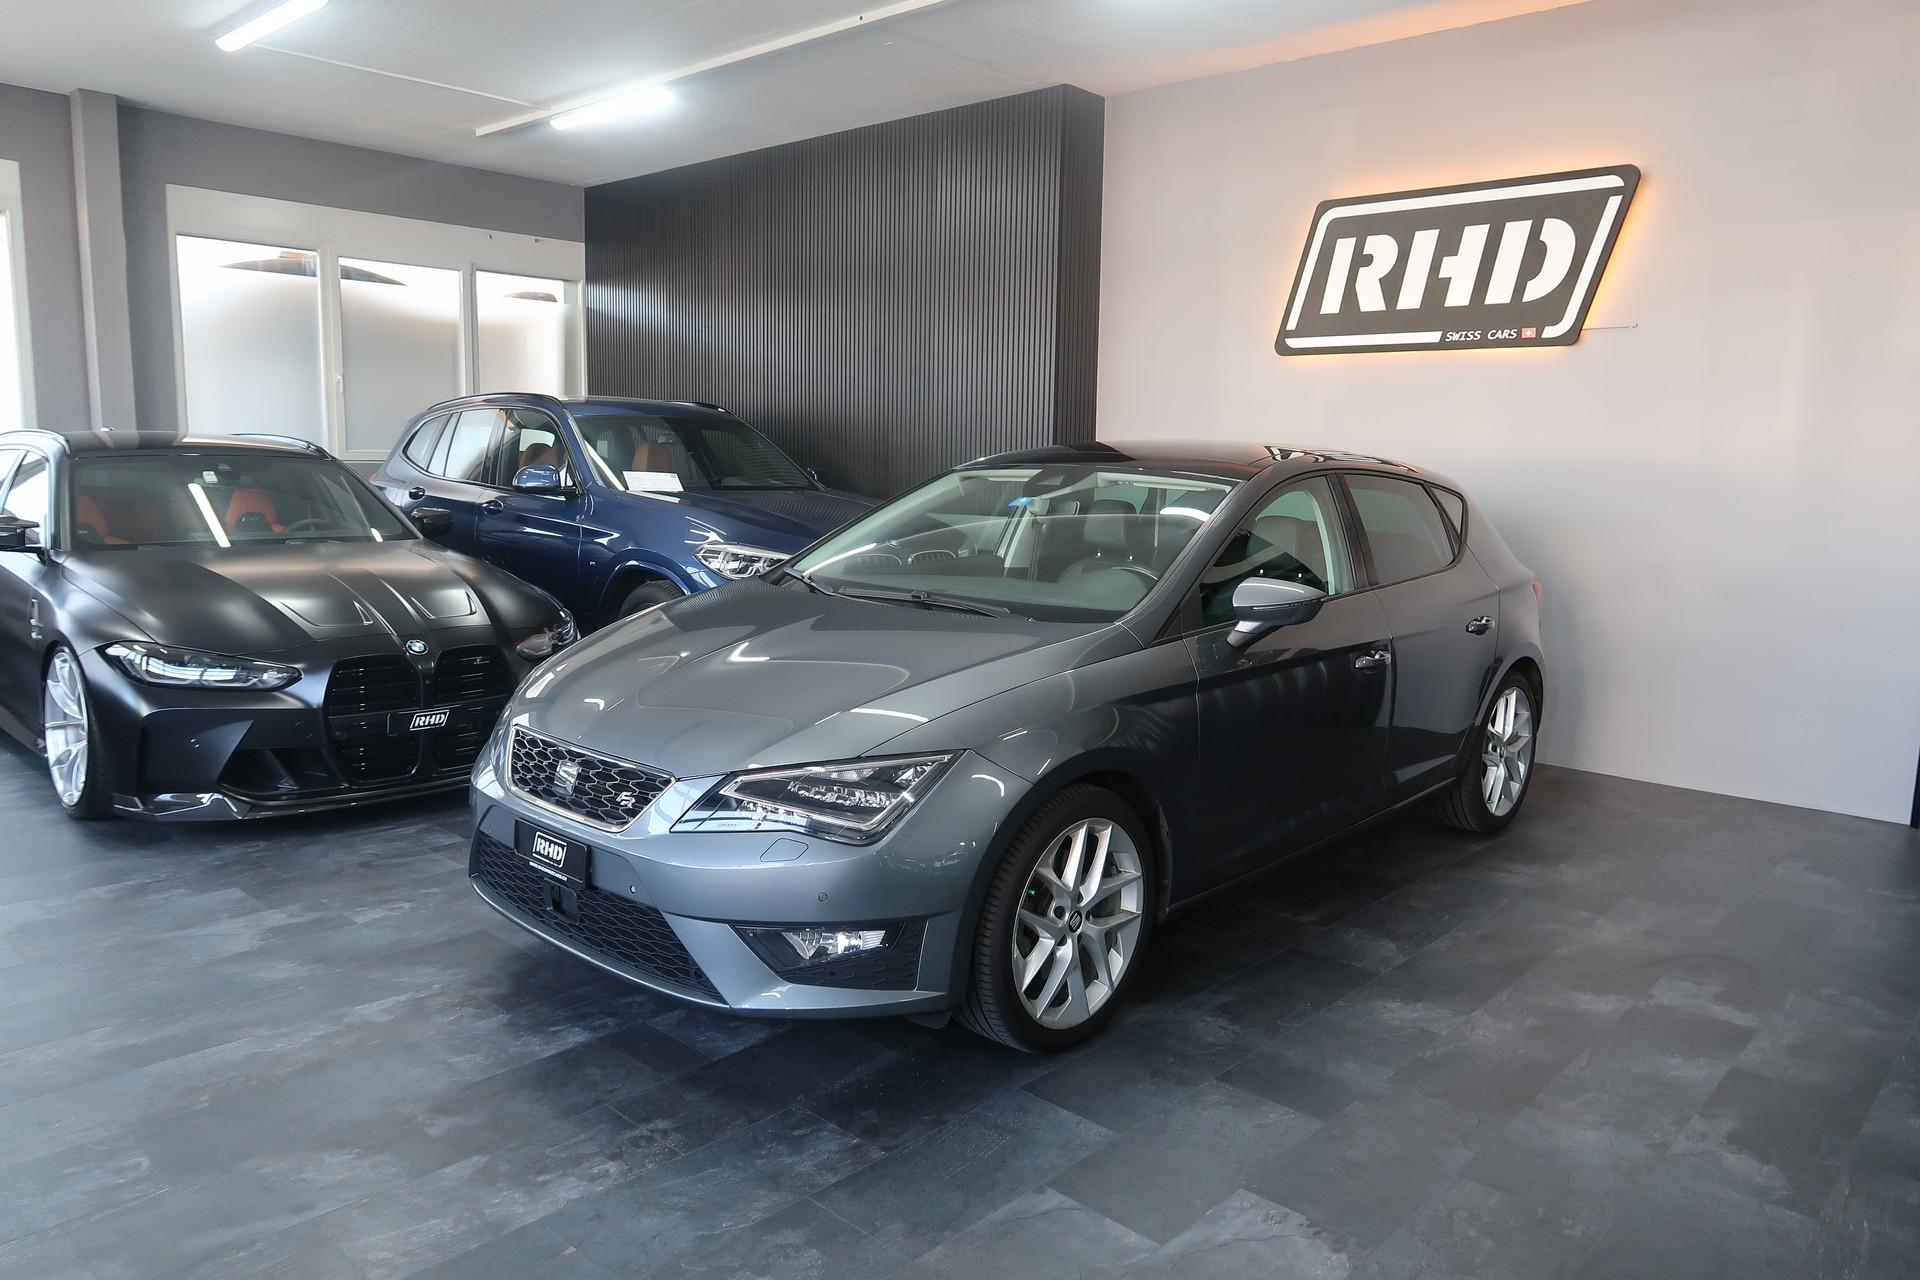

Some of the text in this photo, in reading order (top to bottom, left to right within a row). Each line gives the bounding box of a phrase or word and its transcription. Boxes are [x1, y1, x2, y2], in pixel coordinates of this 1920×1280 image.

[1320, 217, 1576, 315] RHD
[1445, 328, 1518, 342] SWISS CARS
[414, 713, 446, 727] RHD
[536, 837, 563, 861] RHD
